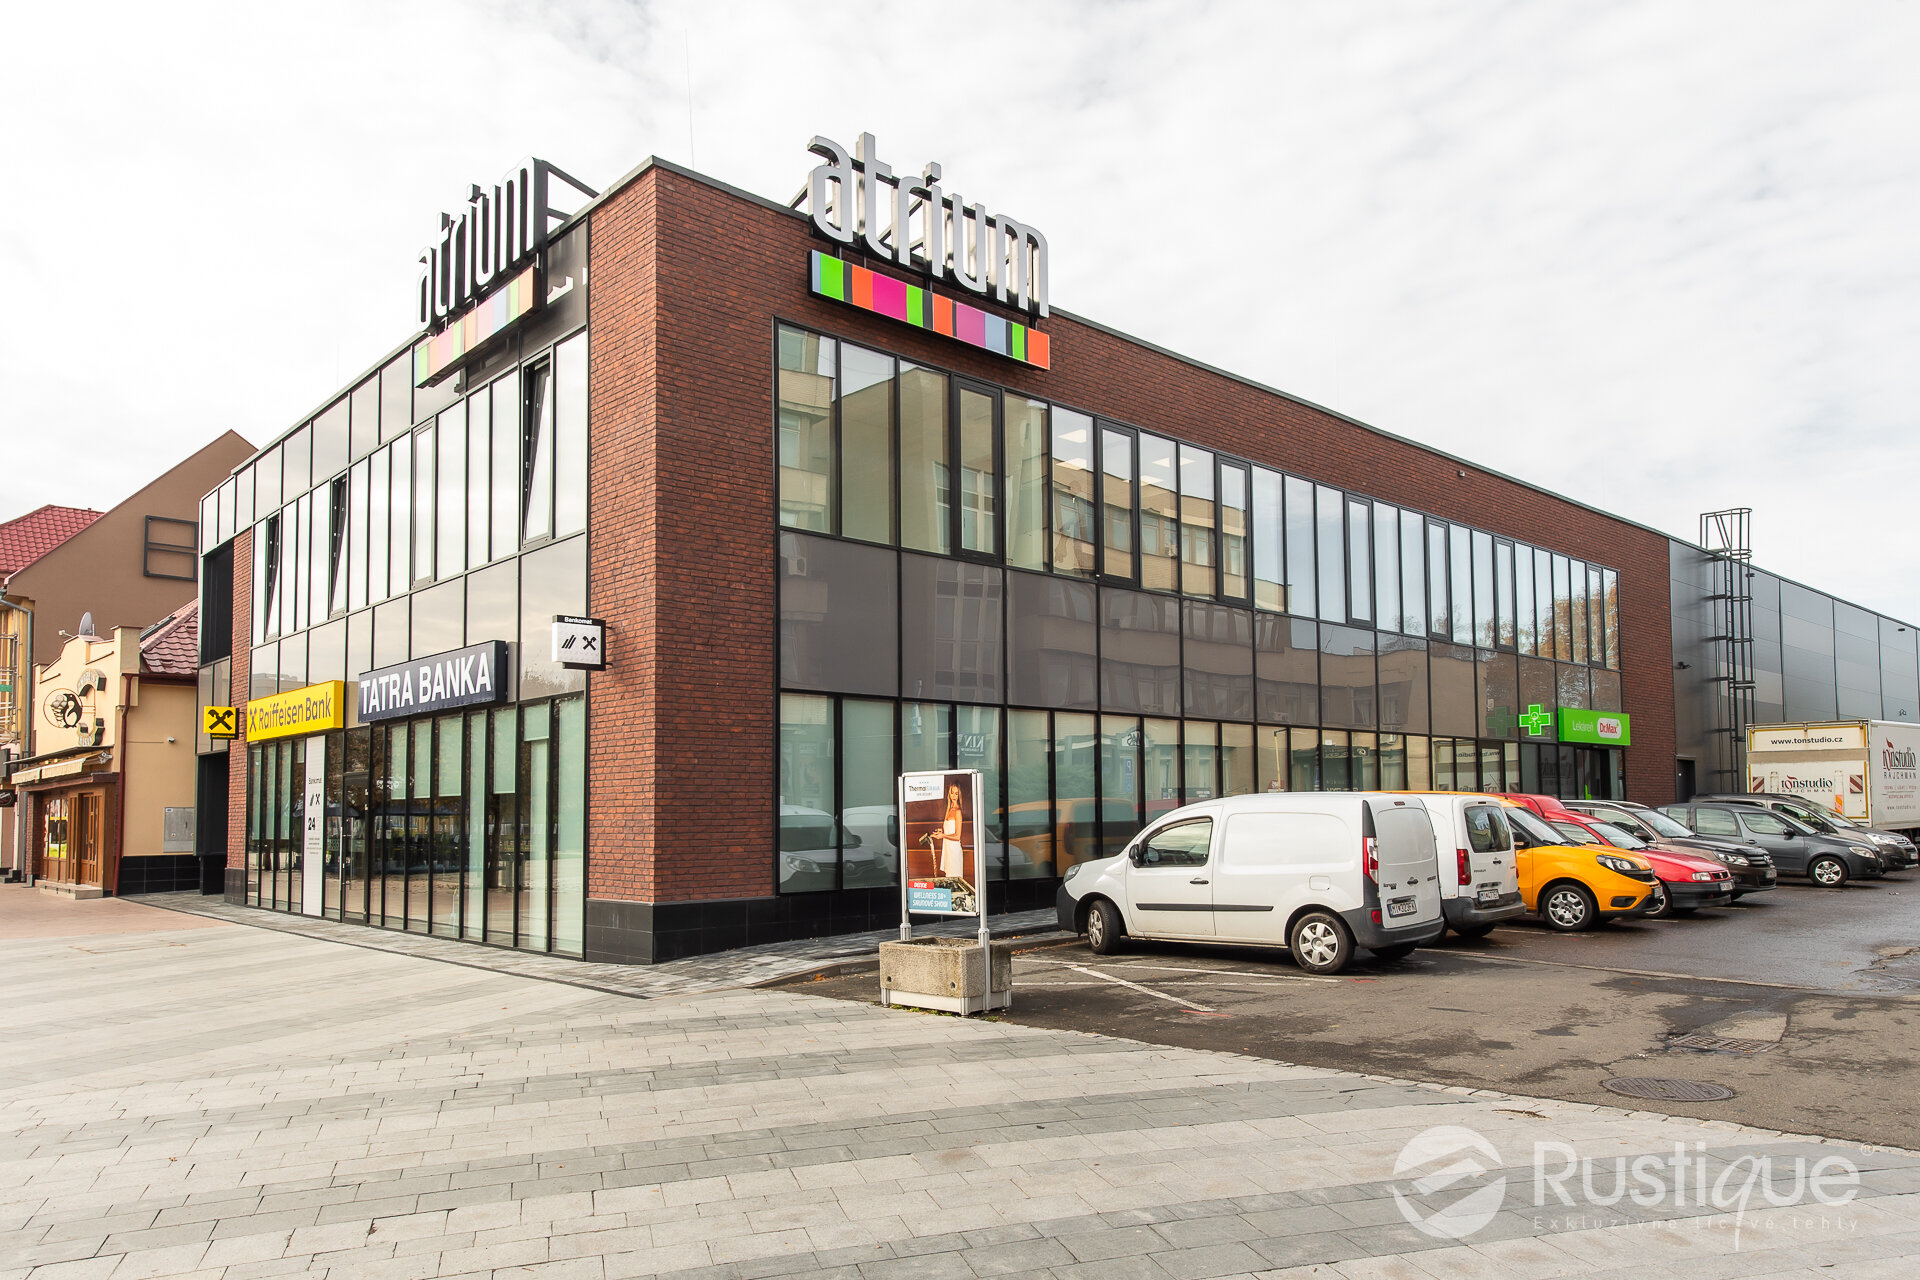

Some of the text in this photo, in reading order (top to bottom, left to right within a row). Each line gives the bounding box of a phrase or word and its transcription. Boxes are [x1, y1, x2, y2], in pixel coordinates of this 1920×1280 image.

[807, 132, 1049, 318] atrium
[416, 155, 541, 333] atrium
[360, 652, 492, 715] TATRA BANKA
[258, 691, 331, 730] Raiffeisen Bank
[1771, 737, 1843, 745] www.tonstudio.cz
[1882, 747, 1917, 771] tonstudio
[1883, 771, 1917, 779] RAJCHMAN
[1781, 777, 1833, 789] tonstudio
[307, 817, 316, 831] 24
[913, 891, 937, 900] WELLNESS
[912, 899, 934, 908] SAUNOVÉ
